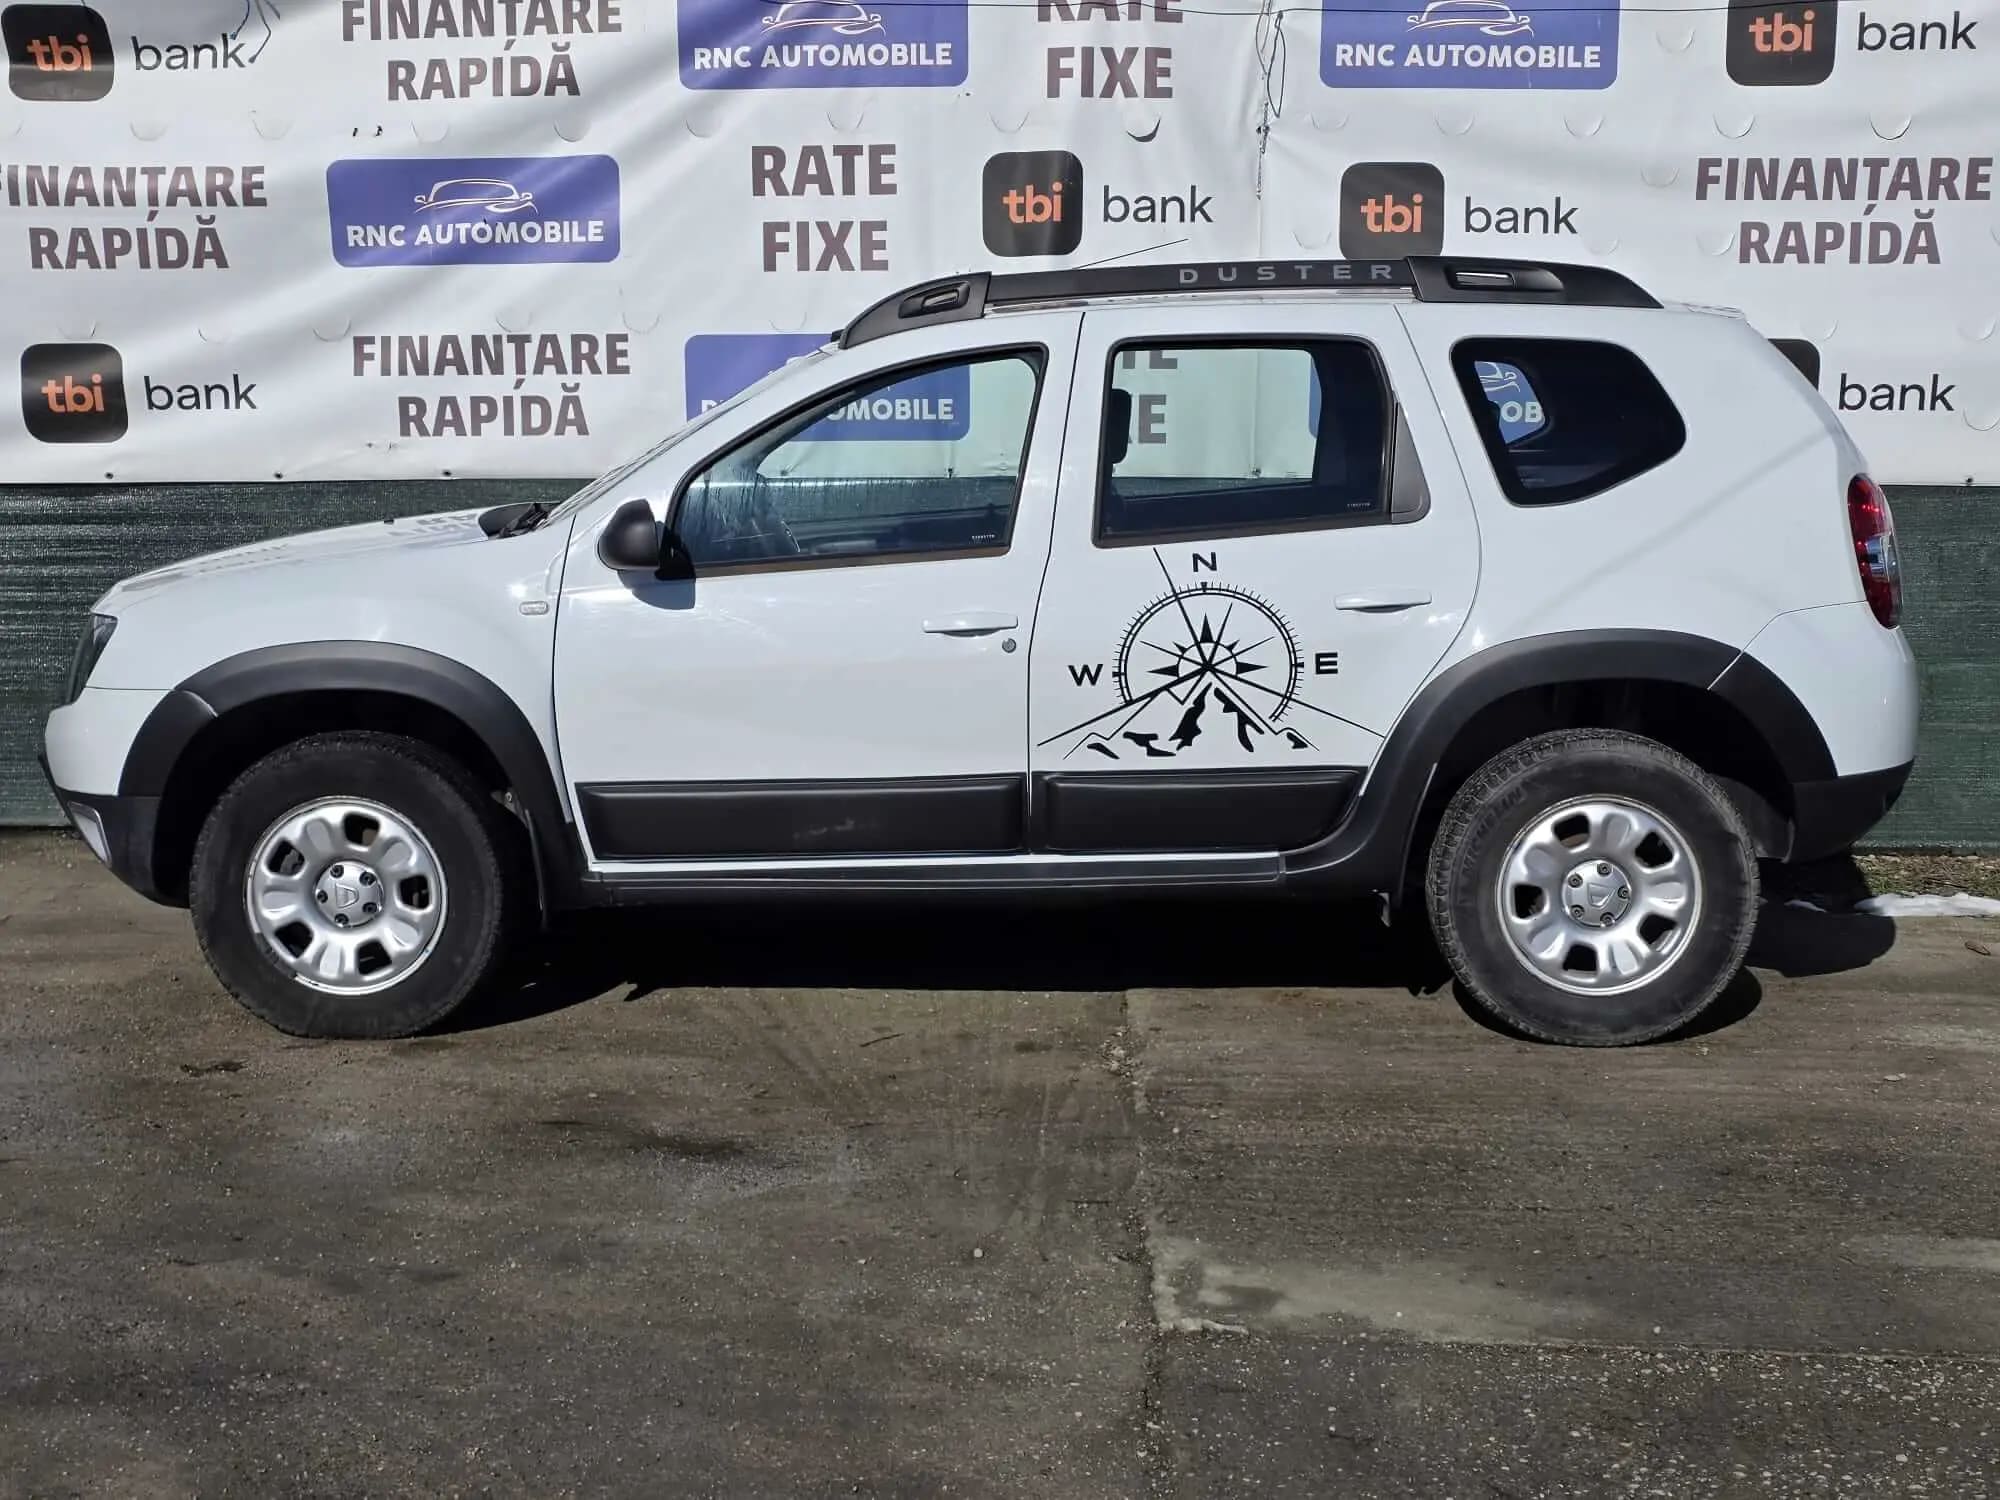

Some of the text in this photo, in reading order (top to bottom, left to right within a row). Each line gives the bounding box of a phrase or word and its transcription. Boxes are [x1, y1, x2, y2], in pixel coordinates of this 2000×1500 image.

[27, 33, 246, 72] tbi bank
[1748, 11, 1978, 54] tbi bank
[387, 41, 581, 101] RAPIDĂ
[694, 43, 953, 70] RNC AUTOMOBILE
[1046, 46, 1174, 99] FIXE
[1335, 44, 1601, 69] RNC AUTOMOBILE
[750, 143, 898, 197] RATE
[0, 164, 269, 223] INANȚARE
[1002, 180, 1214, 224] tbi bank
[1360, 193, 1579, 234] tbi bank
[28, 214, 230, 270] RAPIDĂ
[346, 219, 605, 248] RNC AUTOMOBILE
[761, 220, 889, 273] FIXE
[1738, 208, 1941, 265] RAPIDĂ
[1179, 264, 1392, 284] DUSTER
[41, 373, 257, 414] tbi bank
[398, 383, 589, 437] RAPIDĂ
[1838, 373, 1956, 412] bank
[1192, 551, 1218, 573] N
[1067, 663, 1104, 687] W
[1314, 651, 1339, 675] E
